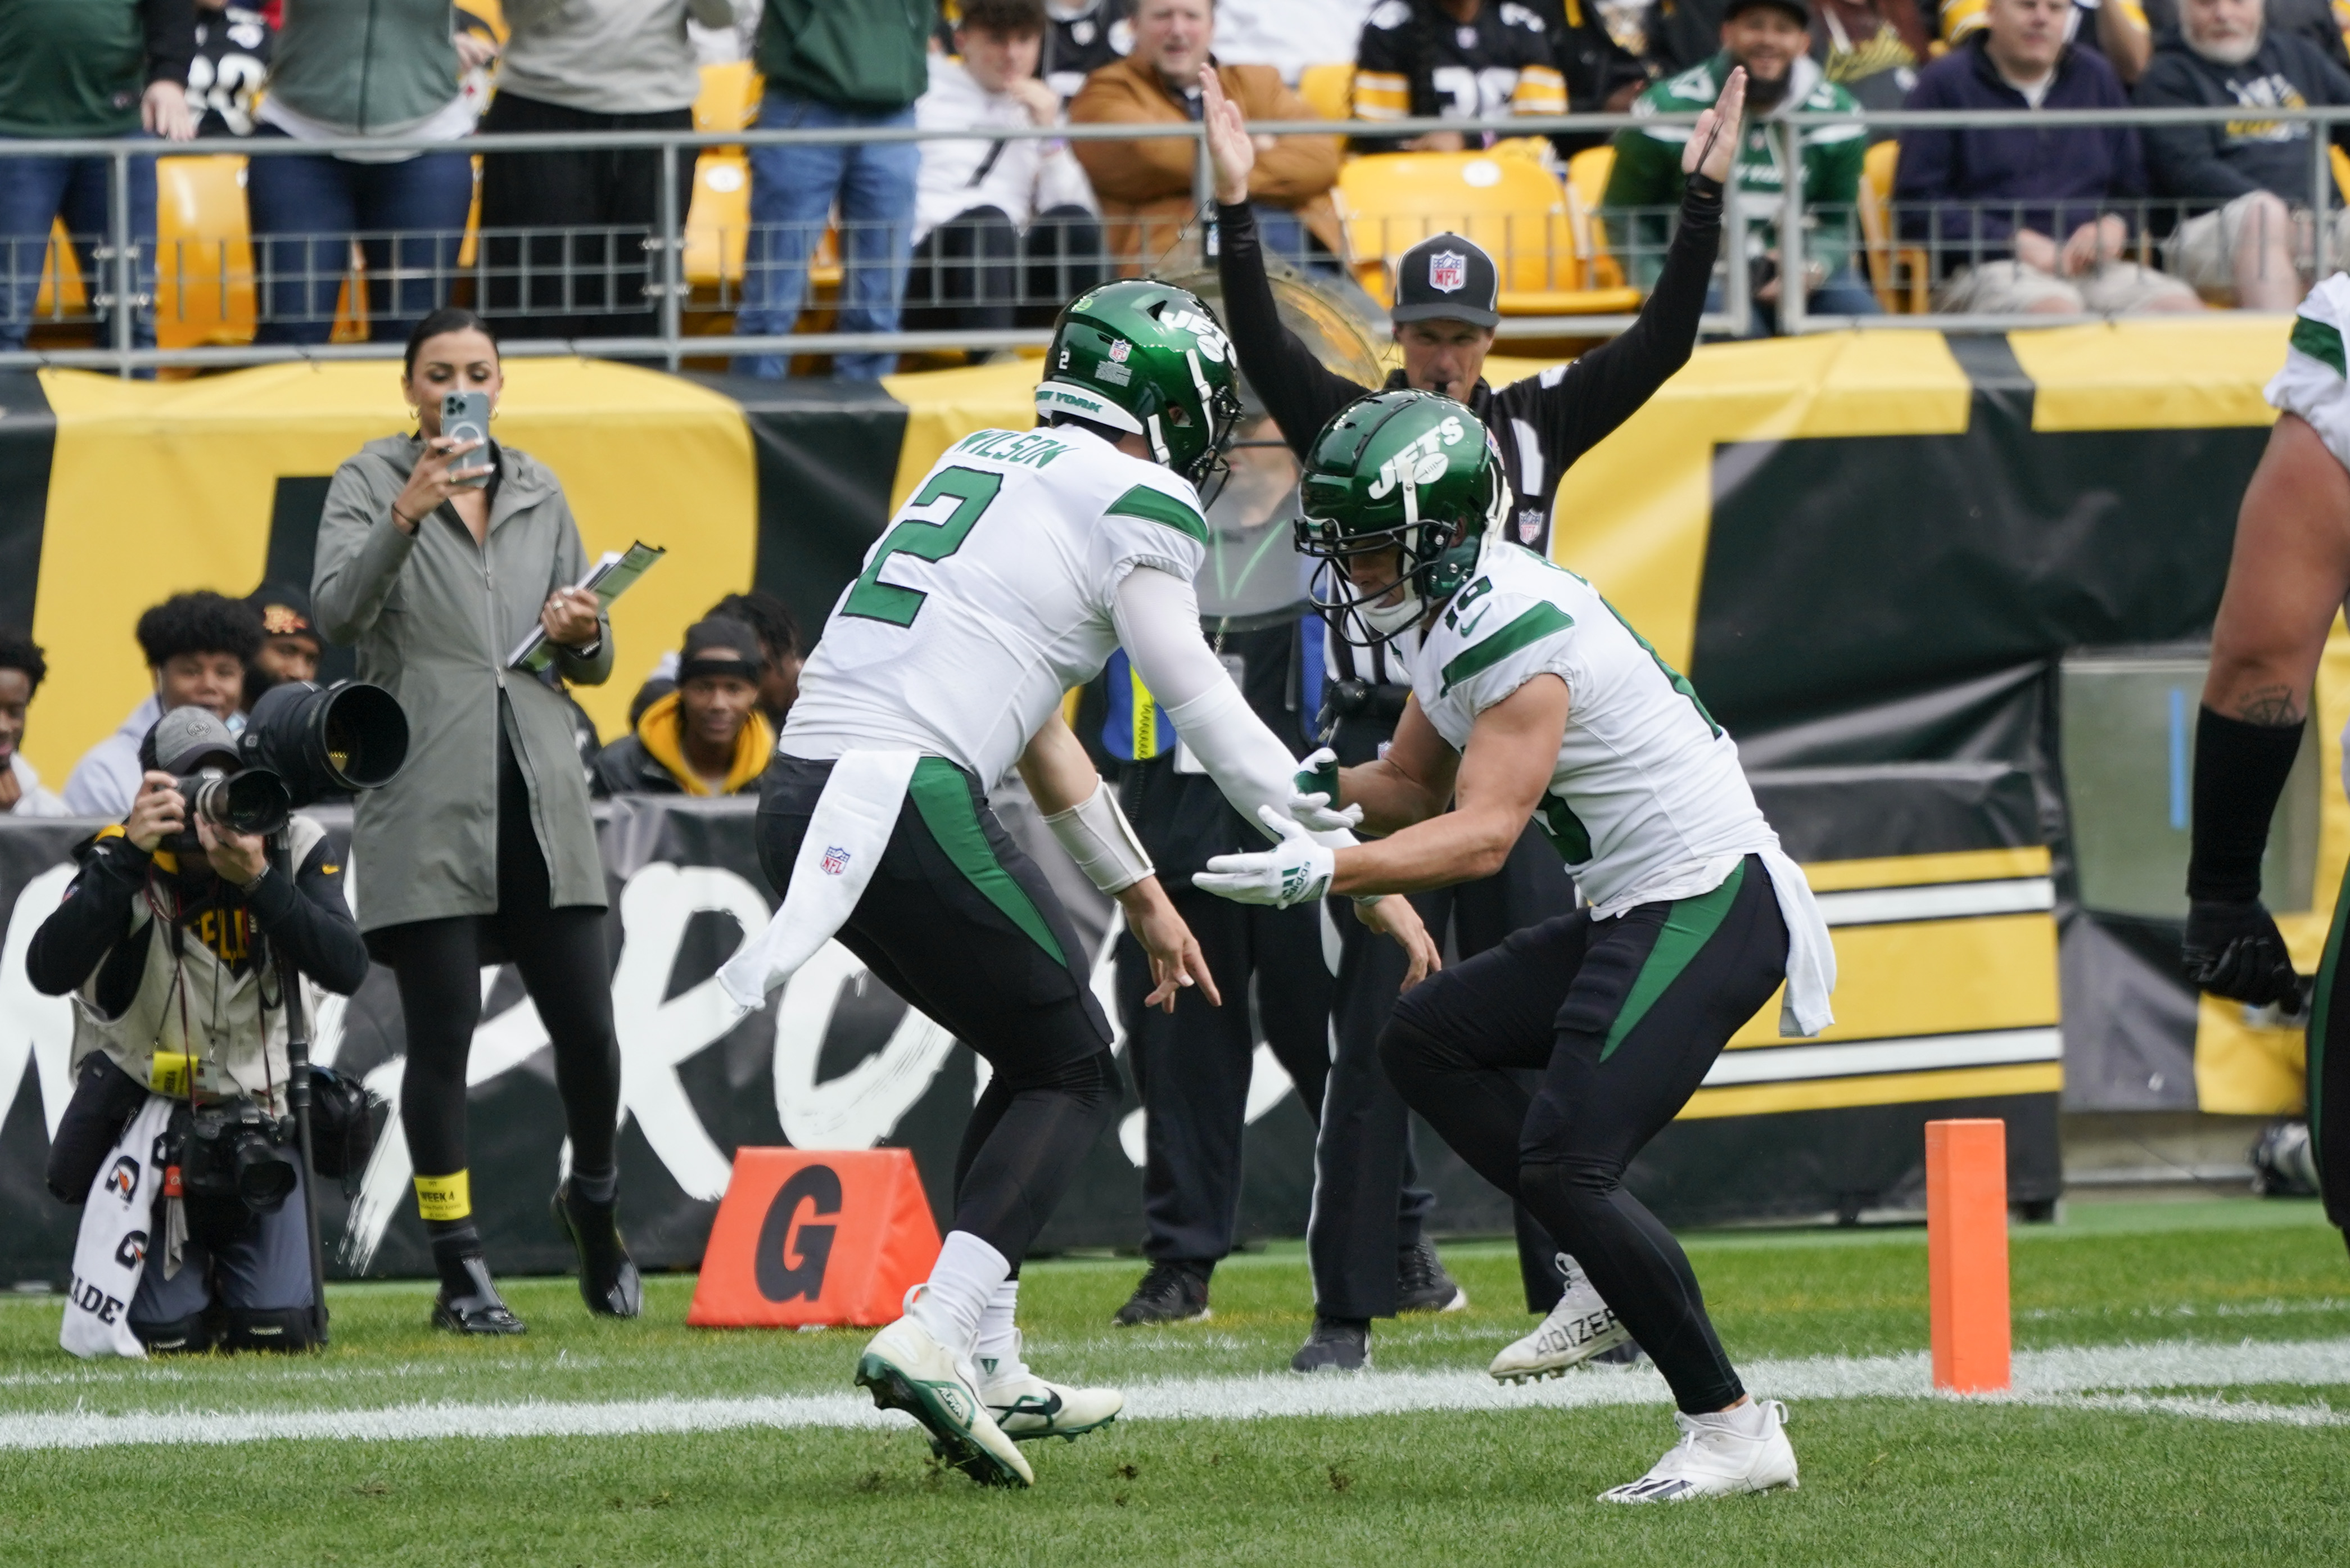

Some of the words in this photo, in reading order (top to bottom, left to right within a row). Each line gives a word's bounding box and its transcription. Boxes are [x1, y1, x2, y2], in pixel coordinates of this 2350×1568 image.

[1058, 350, 1070, 370] 2
[1055, 392, 1103, 413] YORK
[953, 430, 1081, 469] WILSON
[1368, 415, 1465, 500] JETS
[838, 465, 1004, 629] 2
[419, 1191, 447, 1203] WEEK
[449, 1191, 455, 1201] 4
[754, 1164, 842, 1303] G
[937, 1387, 962, 1418] ALPHA
